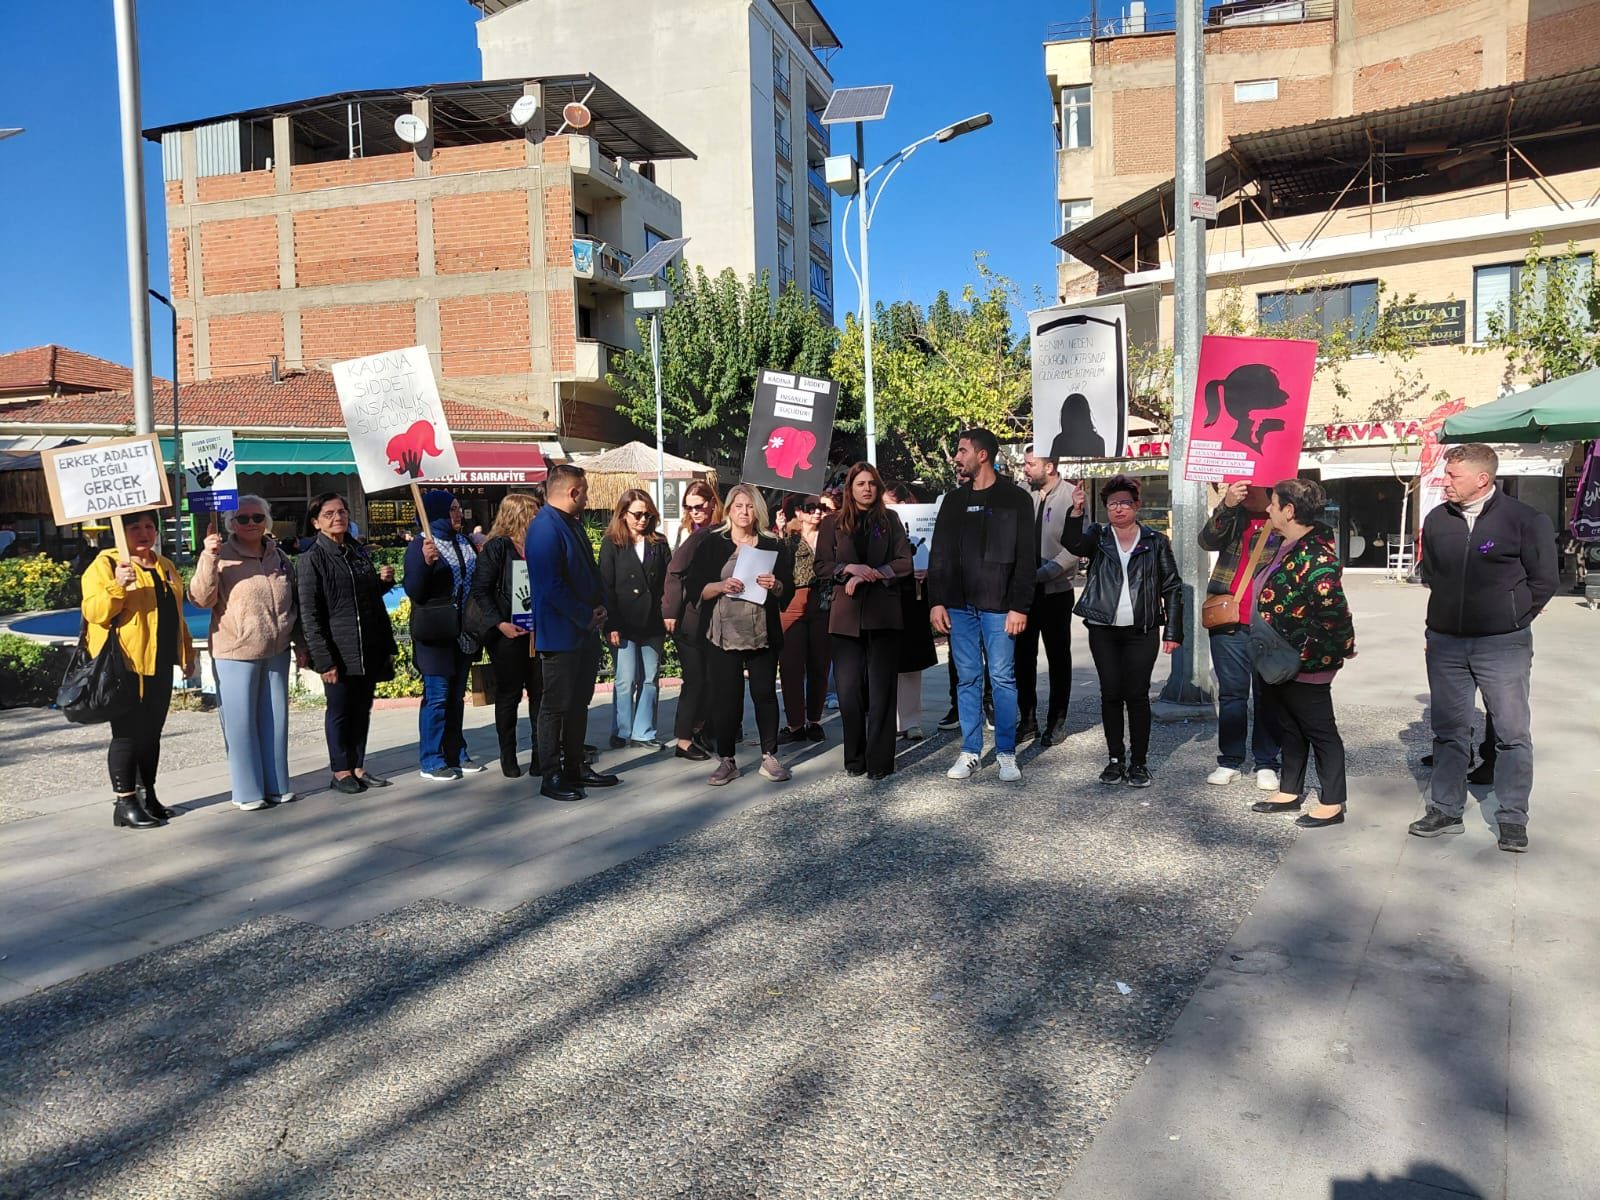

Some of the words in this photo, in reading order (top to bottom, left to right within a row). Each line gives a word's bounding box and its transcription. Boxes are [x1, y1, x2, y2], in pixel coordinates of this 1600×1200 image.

[347, 354, 412, 377] KADINA
[1323, 422, 1388, 441] TAVA
[58, 453, 99, 469] ERKEK
[103, 445, 149, 463] ADALET
[83, 474, 142, 496] GERÇEK
[470, 470, 526, 482] SARRAFİYE
[87, 490, 147, 512] ADALET!
